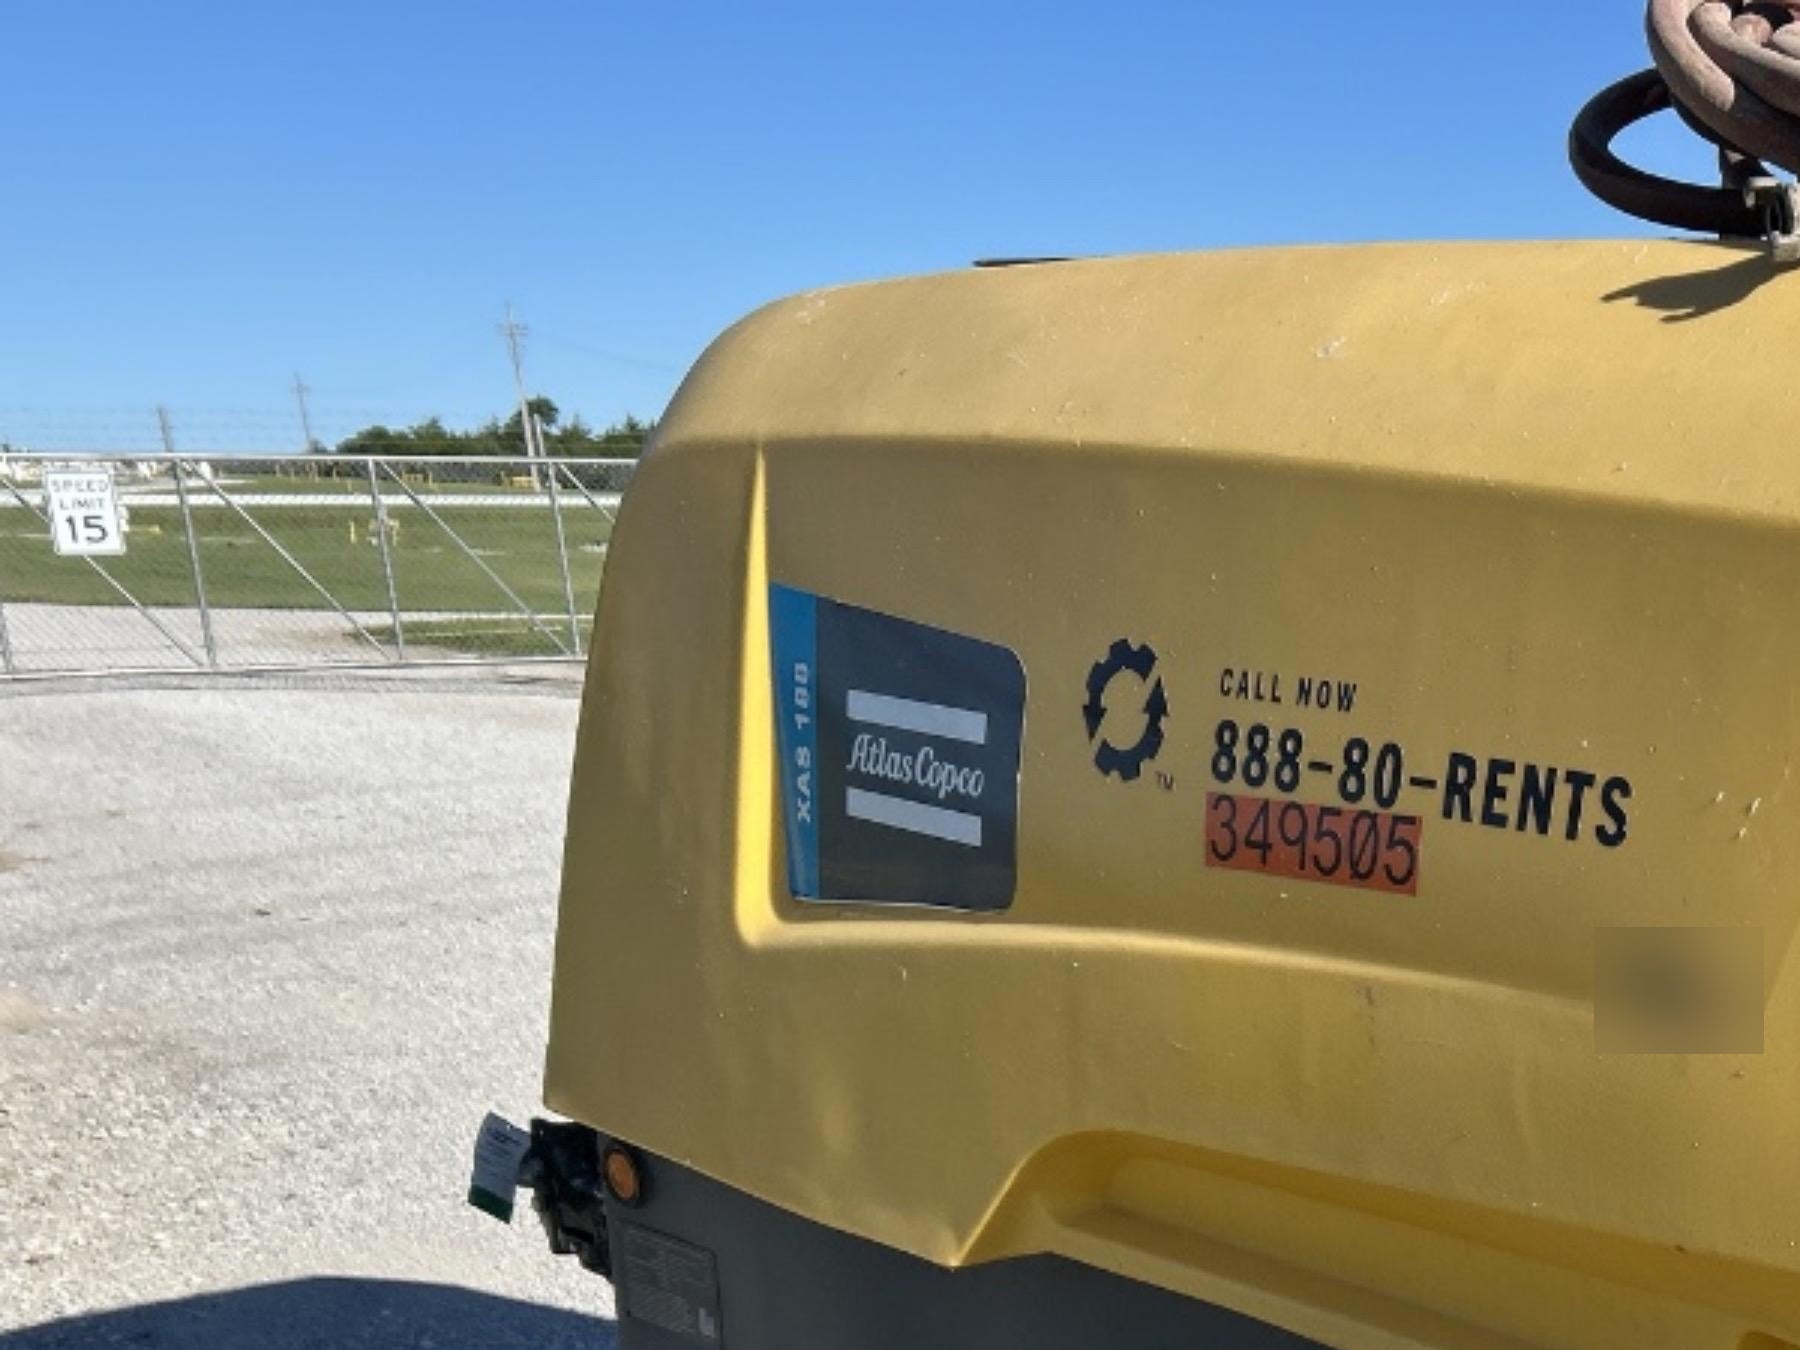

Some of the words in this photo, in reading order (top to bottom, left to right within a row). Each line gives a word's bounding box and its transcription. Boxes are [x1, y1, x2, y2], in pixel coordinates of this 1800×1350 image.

[51, 480, 108, 493] SPEED
[59, 497, 105, 510] LIMIT
[65, 514, 109, 544] 15
[1219, 667, 1282, 704] CALL
[1296, 681, 1358, 713] NOW
[796, 746, 811, 824] XAS
[1211, 718, 1632, 848] 888-80-RENTS
[1210, 794, 1417, 886] 349505
